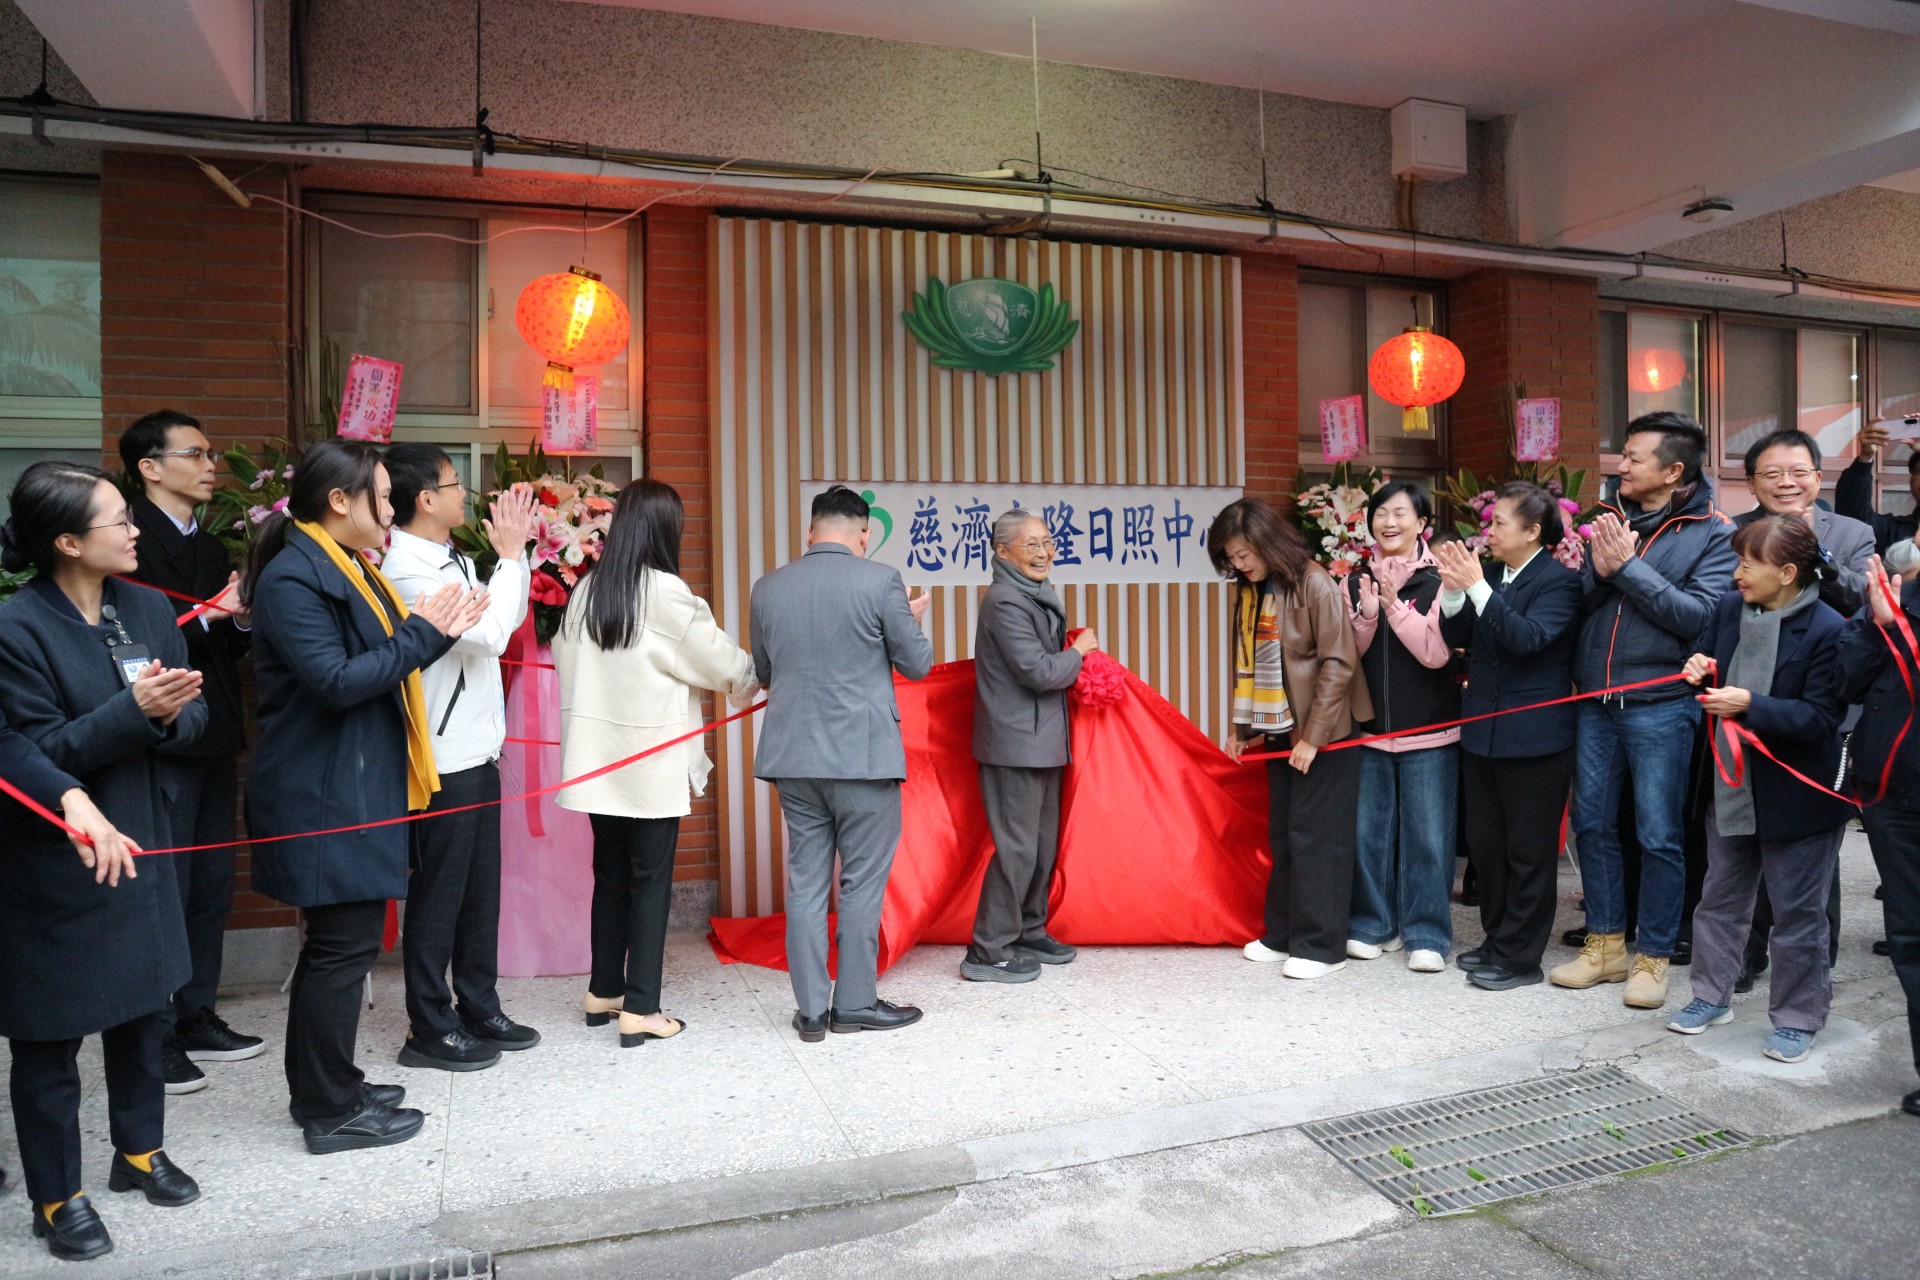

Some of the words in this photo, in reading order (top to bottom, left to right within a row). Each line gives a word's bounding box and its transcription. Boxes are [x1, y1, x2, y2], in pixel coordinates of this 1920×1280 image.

[363, 368, 383, 422] 圓滿成功
[907, 494, 1210, 572] 慈濟隆日照中
